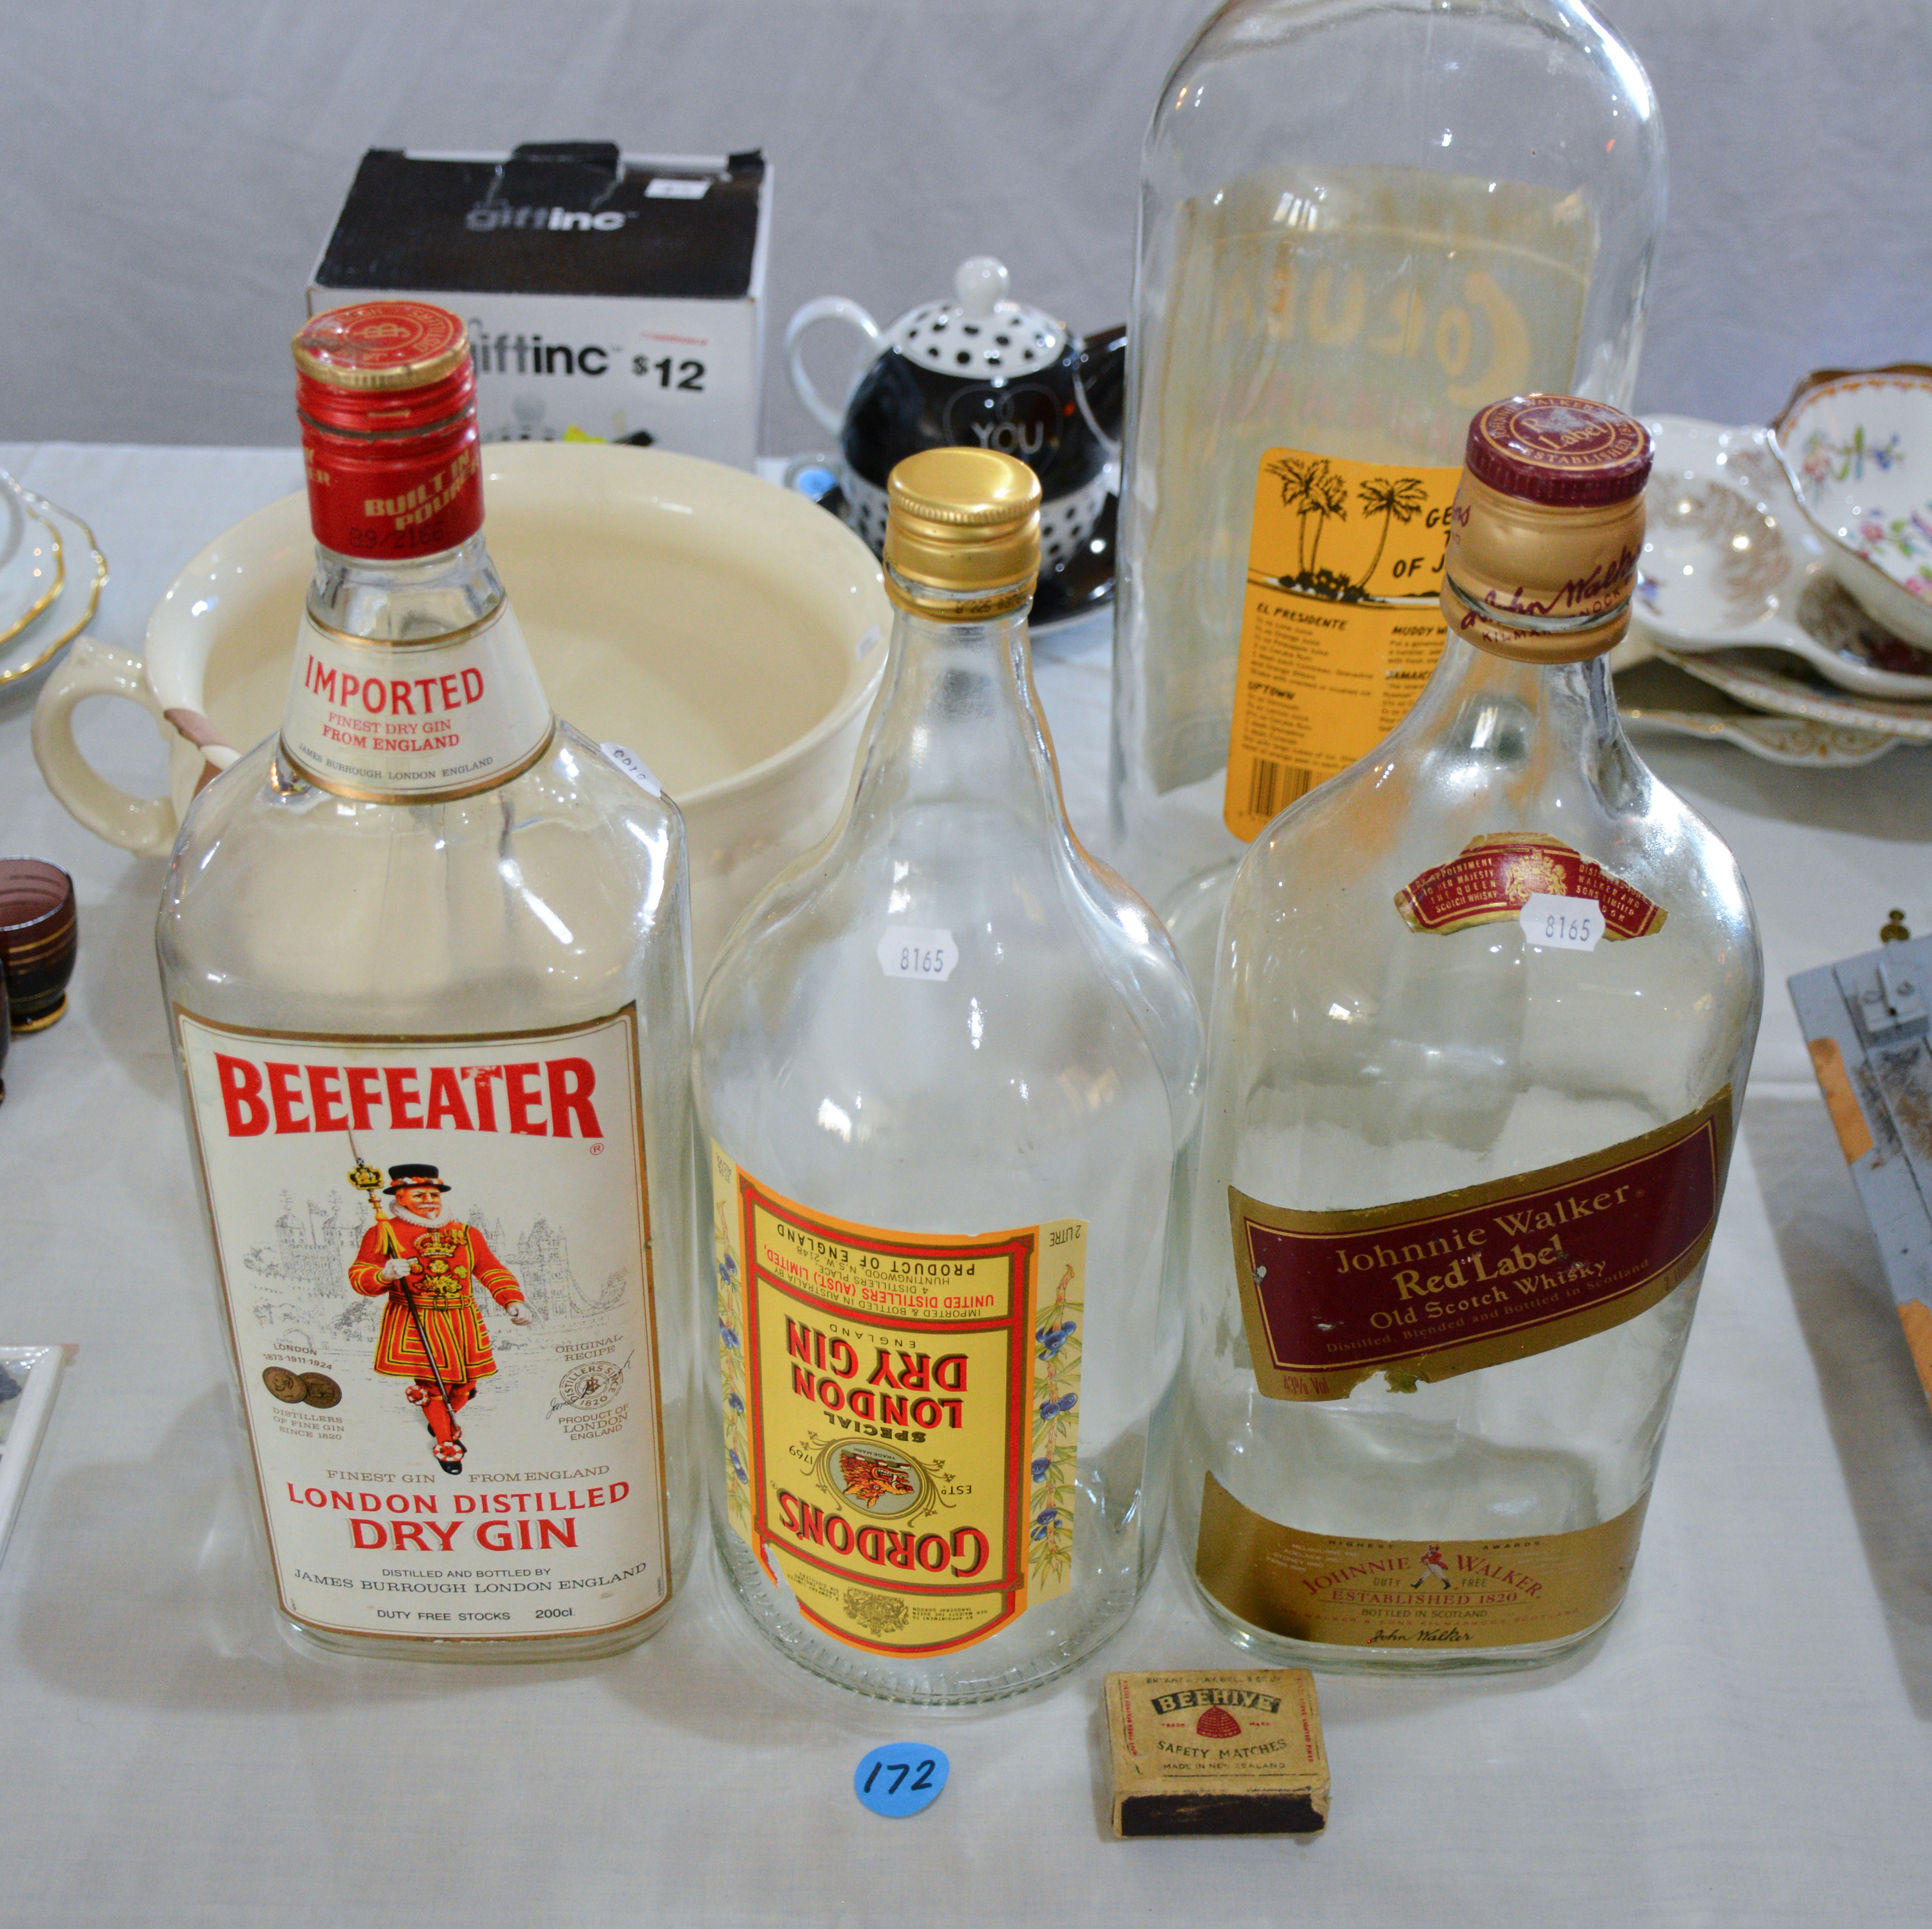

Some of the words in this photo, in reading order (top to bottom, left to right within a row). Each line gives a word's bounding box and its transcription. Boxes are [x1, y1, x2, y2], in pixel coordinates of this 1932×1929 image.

[970, 421, 1045, 453] YOU
[1538, 421, 1607, 450] Label
[1522, 438, 1631, 464] ESTABLISHED
[364, 471, 447, 517] BUILT
[1393, 558, 1424, 578] OF
[1274, 607, 1348, 631] PRESIDENTE
[305, 654, 484, 715] IMPORTED
[328, 712, 381, 733] FINEST
[386, 723, 418, 734] DRY
[422, 719, 452, 733] GIN
[322, 724, 367, 748] FROM
[373, 734, 460, 752] ENGLAND
[299, 743, 323, 763] JAMES
[326, 759, 382, 778] BURROUGH
[389, 766, 436, 779] LONDON
[442, 757, 493, 777] ENGLAND
[1423, 887, 1434, 896] TO
[1437, 879, 1453, 891] HER
[1457, 869, 1494, 884] MAJESTY
[1430, 891, 1450, 904] THE
[1456, 880, 1496, 896] QUEEN
[1578, 875, 1618, 896] WALKER
[1620, 894, 1640, 908] AND
[1436, 897, 1466, 913] SCOTCH
[1467, 890, 1497, 902] WHISKY
[1576, 885, 1600, 899] SONS
[1603, 895, 1634, 915] LIMITED
[1545, 915, 1590, 941] 8165
[900, 947, 943, 973] 8165
[213, 1050, 604, 1139] BEEFEATER
[1049, 1226, 1073, 1247] LITRE
[1075, 1225, 1082, 1239] 2
[1335, 1228, 1487, 1274] Johnnie
[1492, 1184, 1630, 1236] Walker
[777, 1223, 849, 1263] ENGLAND
[796, 1246, 819, 1262] 2148
[764, 1244, 809, 1280] LIMITED,
[774, 1266, 784, 1277] BY
[815, 1263, 848, 1281] PLACE,
[862, 1254, 880, 1269] OF
[889, 1260, 975, 1276] PRODUCT
[1392, 1259, 1469, 1300] Red
[1469, 1234, 1564, 1282] Label
[788, 1276, 839, 1301] AUSTRALIA
[814, 1272, 856, 1297] (AUST.)
[854, 1276, 917, 1294] DISTILLERS
[1370, 1306, 1418, 1329] Old
[1425, 1286, 1509, 1319] Scotch
[1512, 1260, 1606, 1295] Whisky
[844, 1296, 854, 1305] IN
[859, 1300, 907, 1316] BOTTLED
[862, 1288, 938, 1308] DISTILLERS
[943, 1294, 994, 1309] UNITED
[1403, 1318, 1465, 1340] Blended
[1471, 1309, 1499, 1323] and
[1505, 1293, 1559, 1315] Bottled
[1566, 1285, 1581, 1297] in
[1586, 1259, 1650, 1291] Scotland
[923, 1309, 981, 1318] IMPORTED
[556, 1334, 624, 1354] ORIGINAL
[785, 1314, 859, 1379] GIN
[830, 1324, 916, 1348] ENGLAND
[274, 1343, 317, 1356] LONDON
[565, 1345, 616, 1361] RECIPE
[263, 1354, 332, 1370] 1873-1911-1924
[866, 1347, 969, 1392] DRY
[564, 1365, 603, 1402] DISTILLERS
[580, 1395, 608, 1407] 1820
[791, 1361, 964, 1429] LONDON
[272, 1407, 343, 1423] DISTILLERS
[273, 1416, 287, 1424] OF
[291, 1420, 320, 1429] FINE
[559, 1409, 612, 1424] PRODUCT
[615, 1403, 629, 1414] OF
[563, 1412, 628, 1434] LONDON
[279, 1425, 314, 1438] SINCE
[571, 1424, 623, 1441] ENGLAND
[823, 1410, 927, 1444] SPECIAL
[789, 1445, 813, 1465] 1769
[854, 1447, 872, 1455] MARK
[873, 1452, 896, 1460] TRADE
[326, 1469, 396, 1483] FINEST
[401, 1474, 436, 1483] GIN
[469, 1472, 521, 1482] FROM
[524, 1465, 610, 1481] ENGLAND
[287, 1482, 439, 1514] LONDON
[453, 1481, 630, 1514] DISTILLED
[348, 1517, 465, 1552] DRY
[475, 1517, 579, 1552] GIN
[777, 1487, 990, 1578] GORDON'S
[1328, 1540, 1395, 1549] HIGHEST
[1482, 1541, 1541, 1550] AWARDS
[294, 1568, 354, 1588] JAMES
[360, 1580, 468, 1594] BURROUGH
[474, 1581, 552, 1593] LONDON
[558, 1562, 647, 1590] ENGLAND
[382, 1569, 443, 1578] DISTILLED
[476, 1569, 531, 1578] BOTTLED
[535, 1568, 551, 1576] BY
[1302, 1557, 1411, 1595] JOHNNIE
[1373, 1577, 1401, 1587] DUTY
[1462, 1578, 1487, 1587] FREE
[1331, 1590, 1470, 1605] ESTABLISHED
[1479, 1591, 1518, 1604] 1820
[377, 1609, 411, 1620] DUTY
[417, 1612, 452, 1621] FREE
[458, 1612, 511, 1621] STOCKS
[1361, 1609, 1412, 1618] BOTTLED
[1431, 1610, 1488, 1618] SCOTLAND
[1371, 1628, 1407, 1642] John
[1416, 1627, 1474, 1642] Walker
[1157, 1689, 1272, 1712] BEEHIVE
[1157, 1740, 1210, 1758] SAFETY
[1219, 1738, 1288, 1759] MATCHES
[864, 1759, 936, 1795] 172
